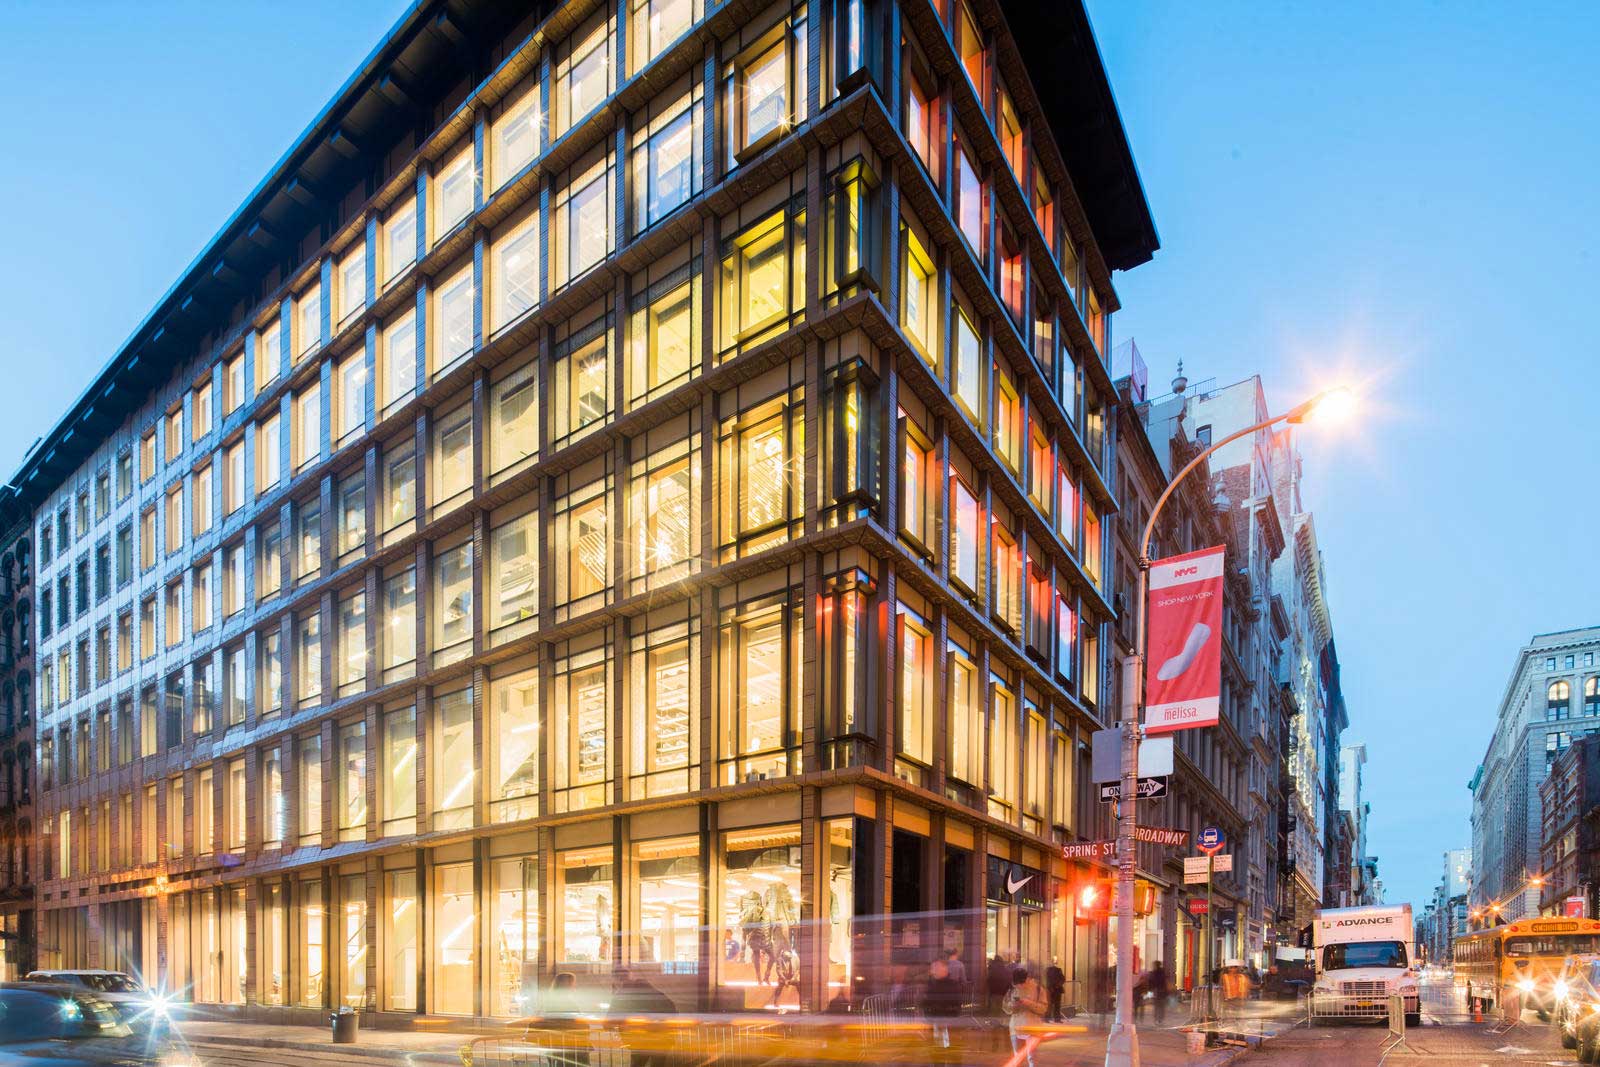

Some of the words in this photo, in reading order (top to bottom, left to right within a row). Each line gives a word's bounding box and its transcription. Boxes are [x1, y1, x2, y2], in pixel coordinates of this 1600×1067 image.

[1174, 566, 1198, 577] NYC
[1158, 598, 1177, 608] SHOP
[1177, 595, 1194, 603] NEW
[1195, 591, 1215, 600] YORK
[1164, 706, 1198, 720] melissa
[1108, 787, 1121, 796] ON
[1136, 782, 1157, 793] WAY
[1063, 844, 1098, 859] SPRING
[1103, 842, 1115, 856] ST
[1336, 916, 1393, 928] ADVANCE
